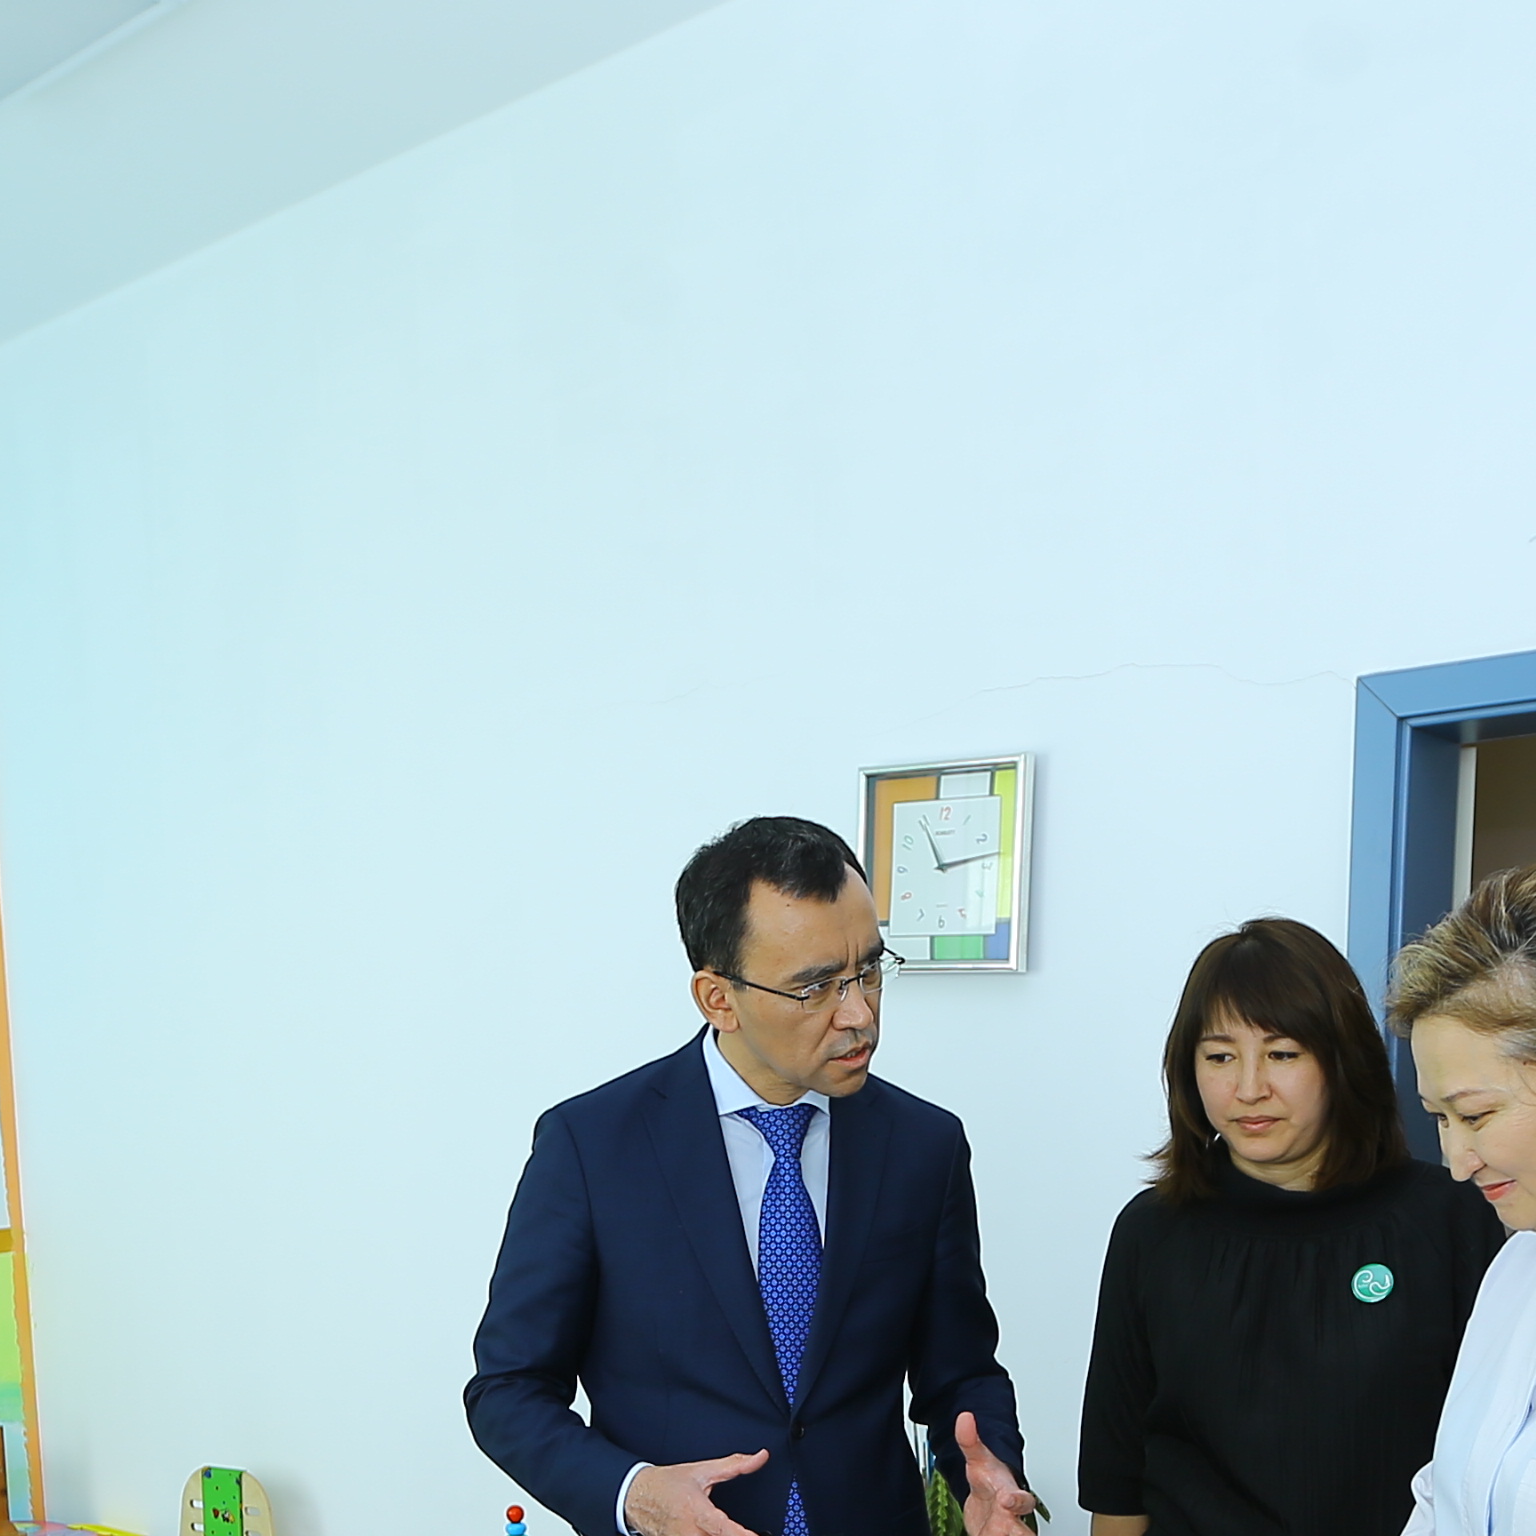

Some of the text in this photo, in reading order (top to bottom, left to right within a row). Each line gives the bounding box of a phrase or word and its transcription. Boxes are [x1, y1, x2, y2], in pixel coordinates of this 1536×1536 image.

[939, 806, 952, 821] 12
[901, 835, 914, 851] 10
[976, 833, 988, 845] 2
[897, 866, 909, 874] 9
[982, 861, 993, 871] 3
[917, 908, 925, 922] 7
[938, 915, 946, 929] 6
